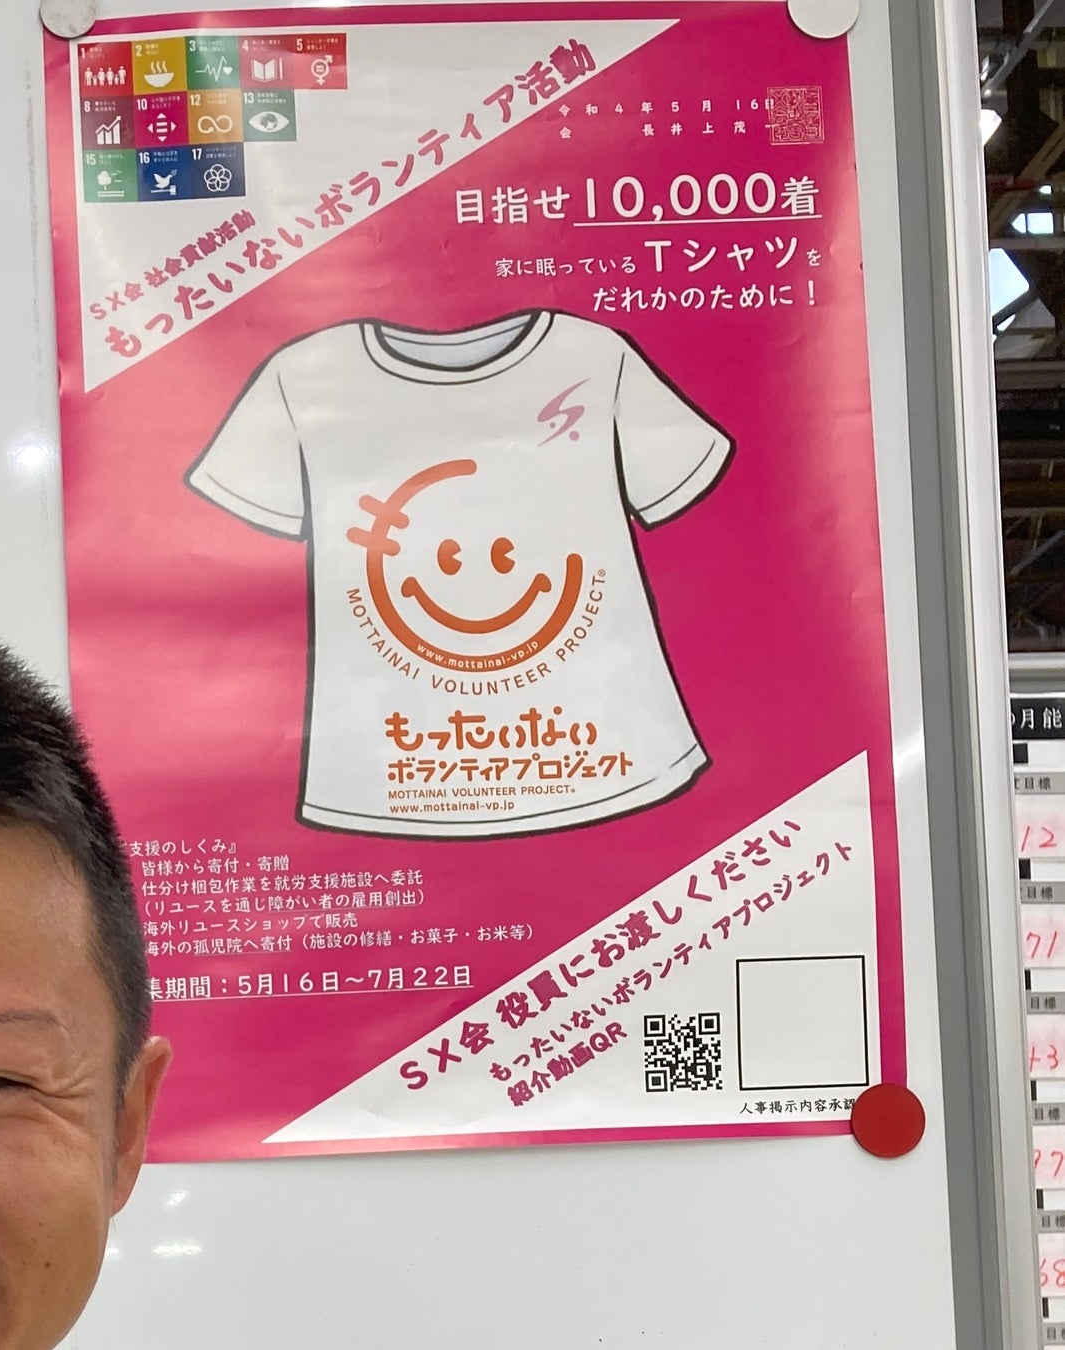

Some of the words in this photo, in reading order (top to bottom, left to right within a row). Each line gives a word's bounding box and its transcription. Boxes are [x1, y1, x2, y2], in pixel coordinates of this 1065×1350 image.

[135, 45, 142, 57] 2
[189, 40, 196, 52] 3
[242, 39, 249, 52] 4
[296, 39, 304, 51] 5
[136, 98, 148, 111] 10
[189, 94, 201, 106] 12
[243, 92, 255, 104] 13
[84, 101, 91, 112] 8
[85, 153, 96, 166] 15
[138, 152, 150, 164] 16
[192, 148, 202, 160] 17
[105, 38, 596, 358] もったいないボランティア活動
[346, 588, 420, 680] MOTTAINAI
[431, 662, 552, 696] VOLUNTEER
[417, 640, 539, 669] www.mottainai-vp.jp
[385, 706, 597, 751] もったいない
[387, 750, 633, 784] ボランティアプロジェクト
[388, 788, 446, 800] MOTTAINAI
[452, 786, 516, 798] VOLUNTEER
[389, 800, 515, 814] www.mottainai-vp.jp
[1021, 825, 1057, 852] 12
[142, 855, 289, 877] 皆様から寄付・寄贈
[142, 869, 423, 897] 仕分け梱包作業を就労支援施設へ委託
[1026, 930, 1057, 958] 71
[490, 841, 853, 1083] もったいないボランティアプロジェクト
[506, 1021, 629, 1108] 紹介動画QR
